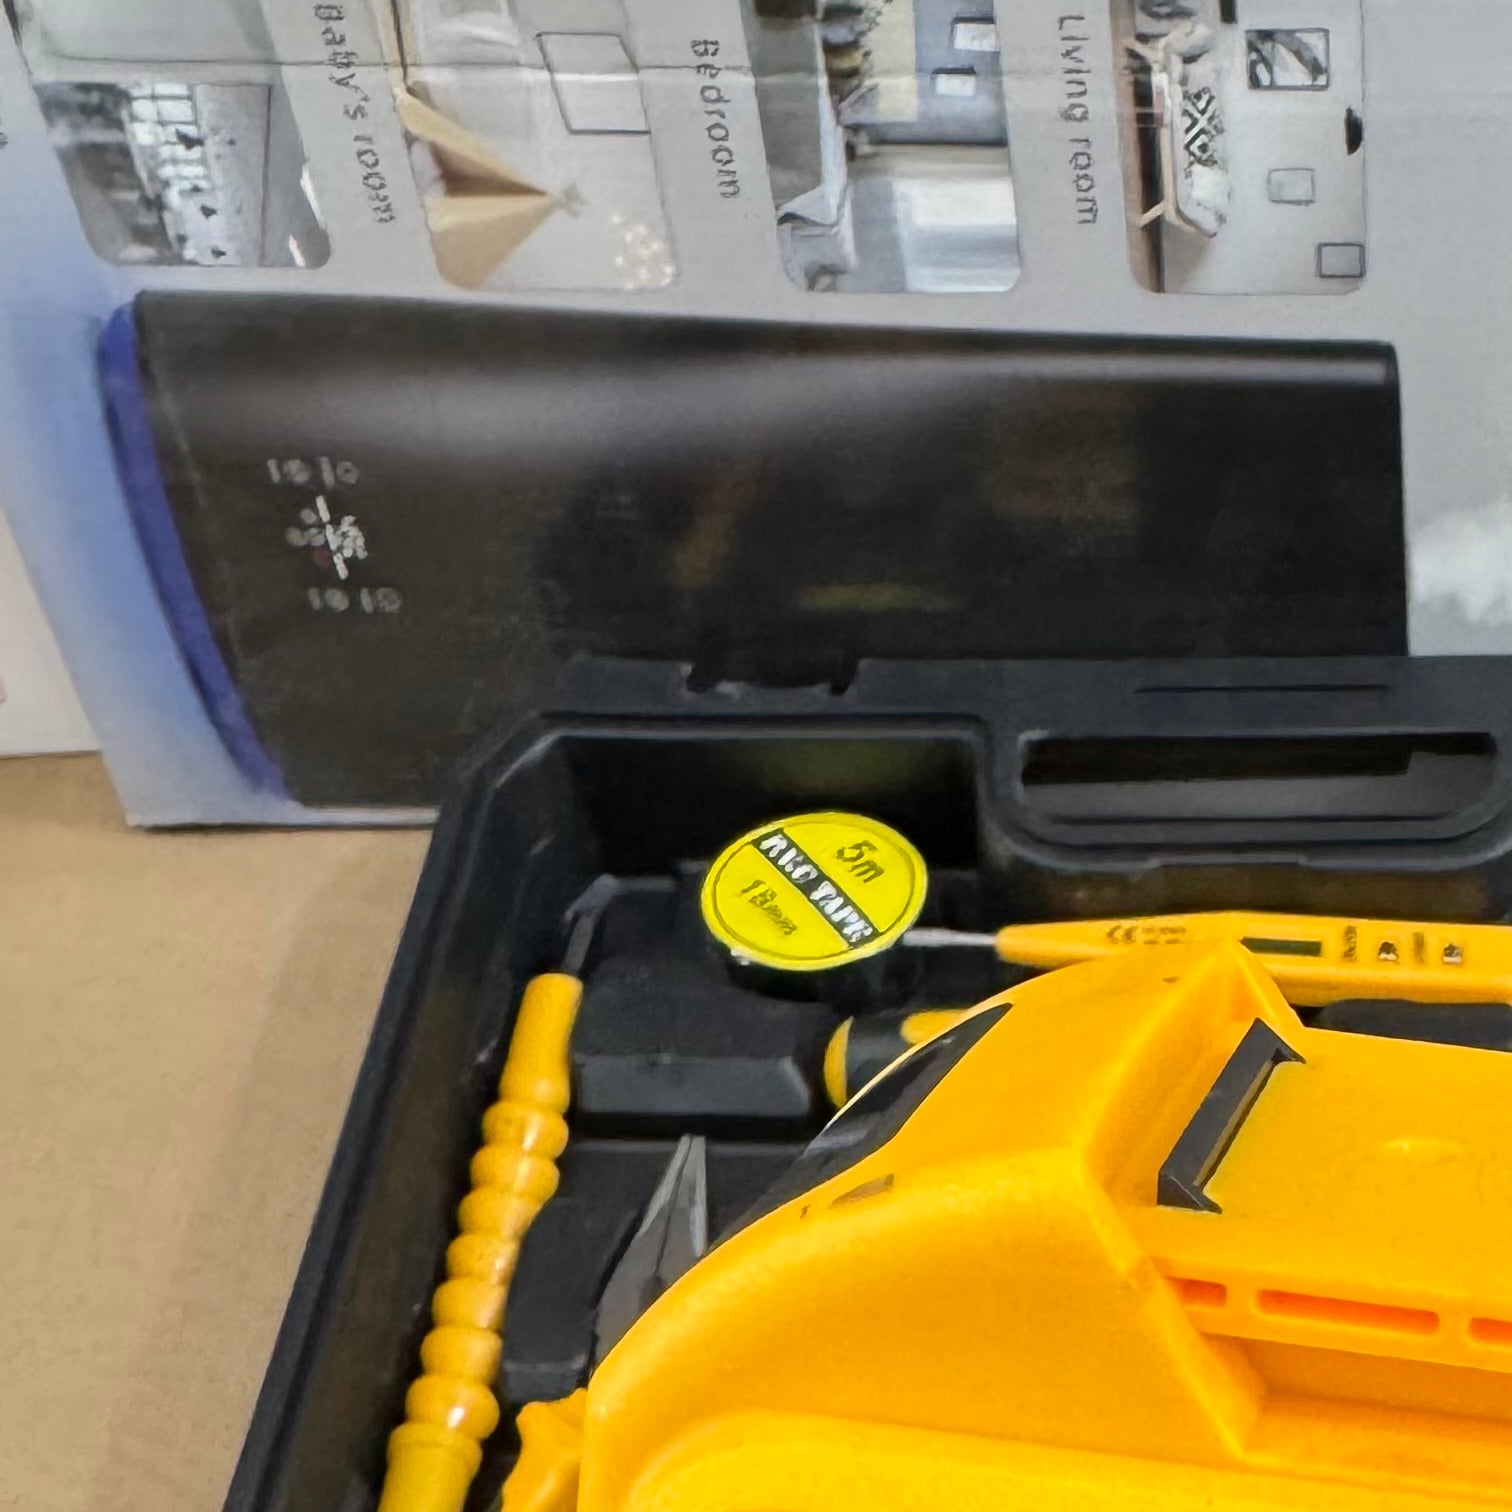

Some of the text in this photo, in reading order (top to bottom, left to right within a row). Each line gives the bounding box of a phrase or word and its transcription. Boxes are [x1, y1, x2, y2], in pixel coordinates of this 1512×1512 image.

[690, 38, 742, 199] Bedroom
[1057, 14, 1099, 225] Living room
